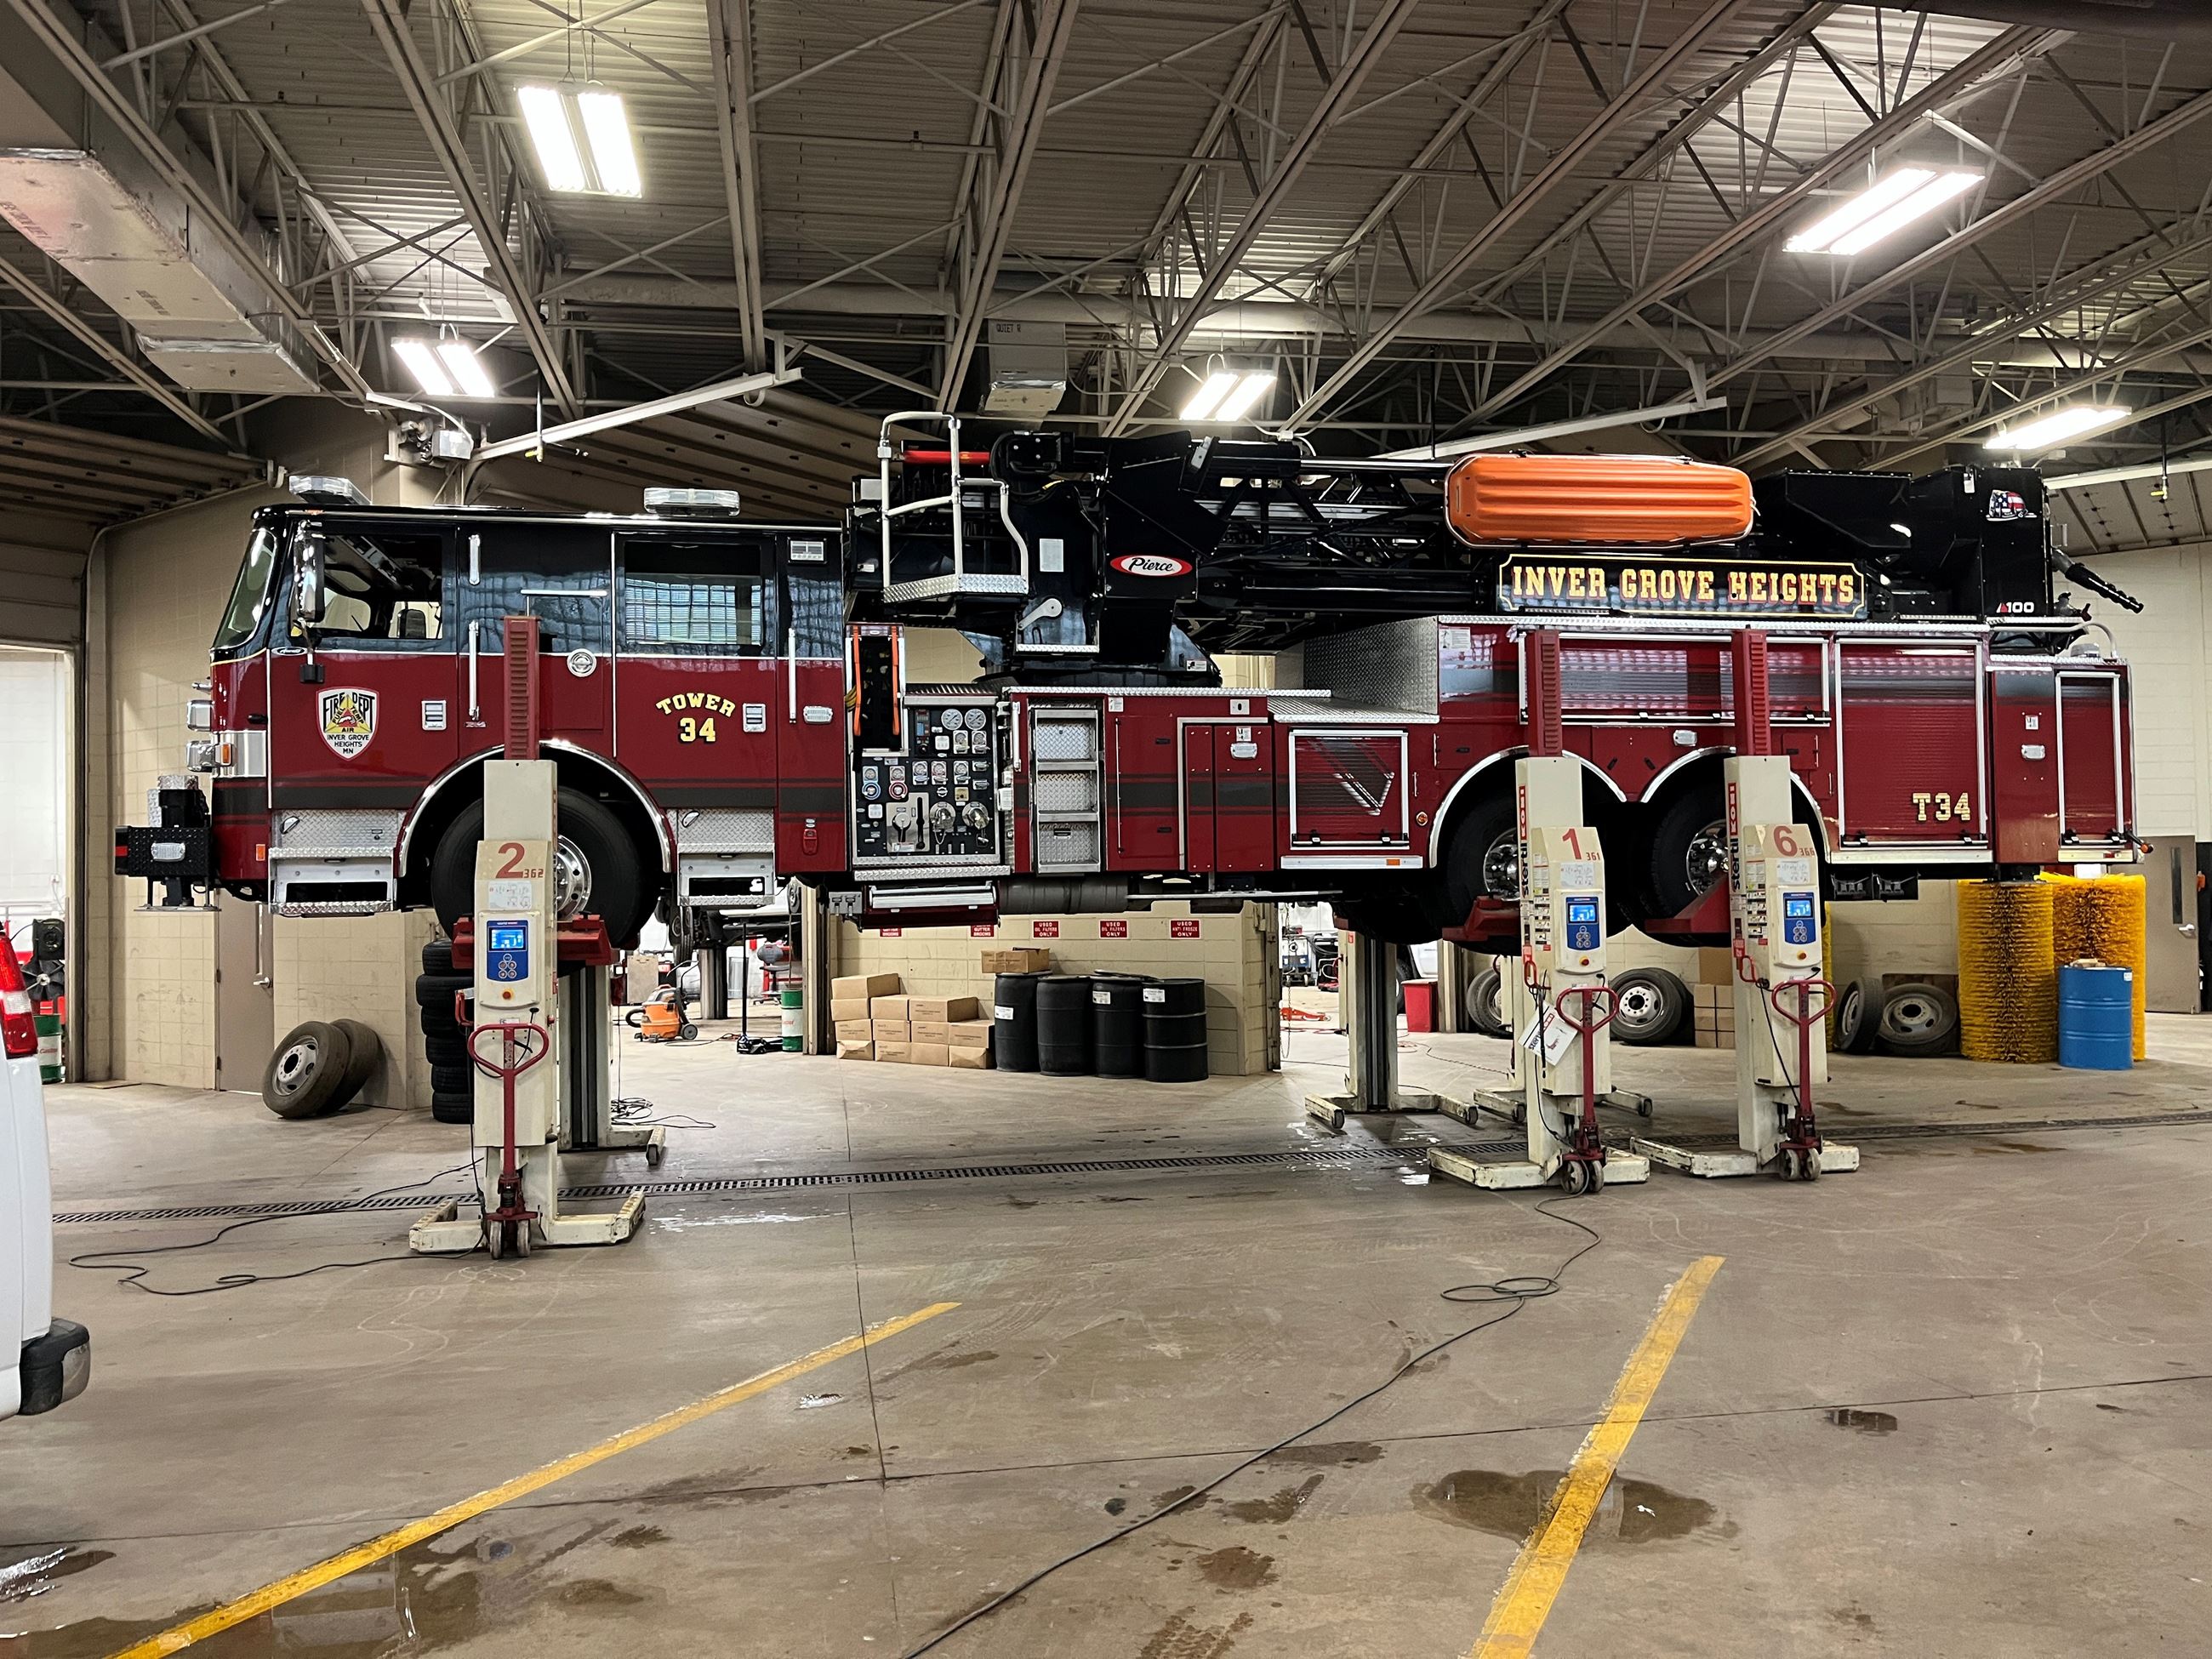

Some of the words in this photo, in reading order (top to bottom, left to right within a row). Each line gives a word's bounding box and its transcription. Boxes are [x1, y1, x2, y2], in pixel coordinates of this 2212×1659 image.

[996, 324, 1014, 333] QUIET
[1128, 557, 1173, 572] Pierce
[1512, 566, 1607, 599] INVER
[1620, 568, 1715, 602] GROVE
[1728, 572, 1855, 605] HEIGHTS
[323, 692, 345, 733] FIRE
[352, 692, 375, 733] DEPT
[332, 708, 345, 724] FUEL
[351, 705, 364, 724] TEMP
[655, 693, 736, 717] TOWER
[680, 717, 716, 742] 34
[1913, 792, 1970, 821] T34
[1562, 829, 1582, 860] 1
[1586, 852, 1600, 861] 361
[1773, 825, 1798, 857] 6
[496, 842, 526, 879] 2
[524, 869, 544, 879] 362
[1520, 842, 1529, 896] stertil
[1730, 838, 1740, 892] stertil
